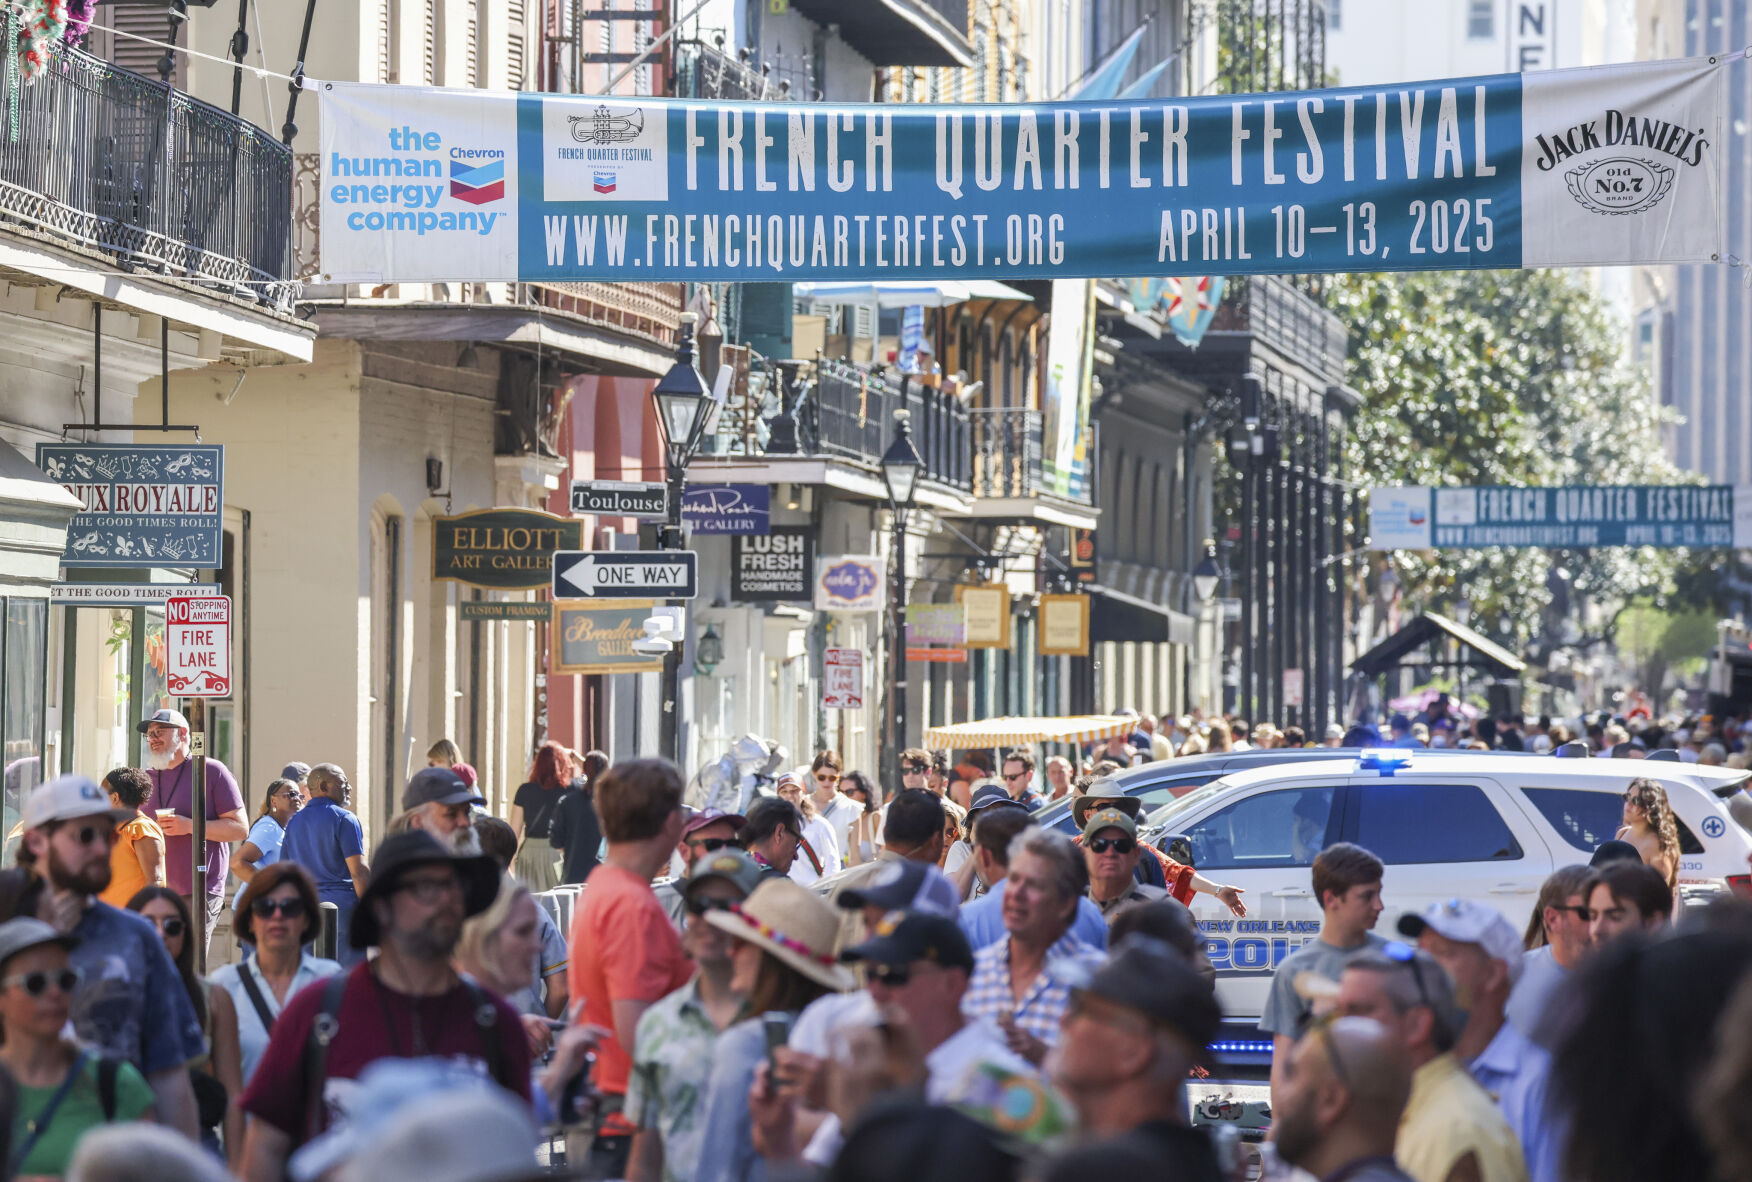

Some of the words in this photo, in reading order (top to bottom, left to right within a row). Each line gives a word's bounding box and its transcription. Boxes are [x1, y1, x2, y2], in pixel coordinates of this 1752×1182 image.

[389, 126, 442, 151] the
[686, 105, 893, 192] FRENCH
[935, 106, 1189, 200] QUARTER
[1231, 85, 1496, 185] FESTIVAL
[1534, 120, 1602, 171] JACK
[1605, 109, 1710, 167] DANIEL'S
[449, 147, 505, 159] Chevron
[558, 148, 584, 160] FRENCH
[587, 148, 619, 161] QUARTER
[622, 149, 653, 161] FESTIVAL
[331, 152, 442, 177] human
[1606, 168, 1631, 177] Old
[330, 184, 444, 208] energy
[1158, 206, 1251, 262] APRIL
[1409, 198, 1494, 254] 2025
[543, 213, 1065, 272] WWW.FRENCHQUARTERFEST.ORG
[63, 485, 110, 512] UX
[116, 485, 217, 513] ROYALE
[574, 491, 664, 511] Toulouse
[1556, 489, 1637, 522] QUARTER
[1647, 489, 1730, 521] FESTIVAL
[97, 517, 133, 527] GOOD
[137, 518, 176, 528] TIMES
[180, 518, 218, 528] ROLL!
[453, 528, 567, 551] ELLIOTT
[741, 535, 804, 553] LUSH
[450, 555, 485, 569] ART
[491, 555, 553, 570] GALLER
[741, 554, 804, 570] FRESH
[597, 566, 635, 584] ONE
[642, 566, 682, 584] WAY
[741, 571, 804, 581] HANDMADE
[67, 588, 92, 597] THE
[95, 588, 131, 598] GOOD
[134, 589, 172, 598] TIMES
[741, 582, 804, 592] COSMETICS
[168, 601, 189, 621] NO
[190, 601, 227, 610] STOPPING
[192, 611, 225, 620] ANYTIME
[465, 606, 502, 616] CUSTOM
[506, 606, 548, 616] FRAMING
[181, 630, 214, 645] FIRE
[179, 652, 217, 667] LANE
[1196, 920, 1234, 933] NEW
[1237, 920, 1320, 934] ORLEANS
